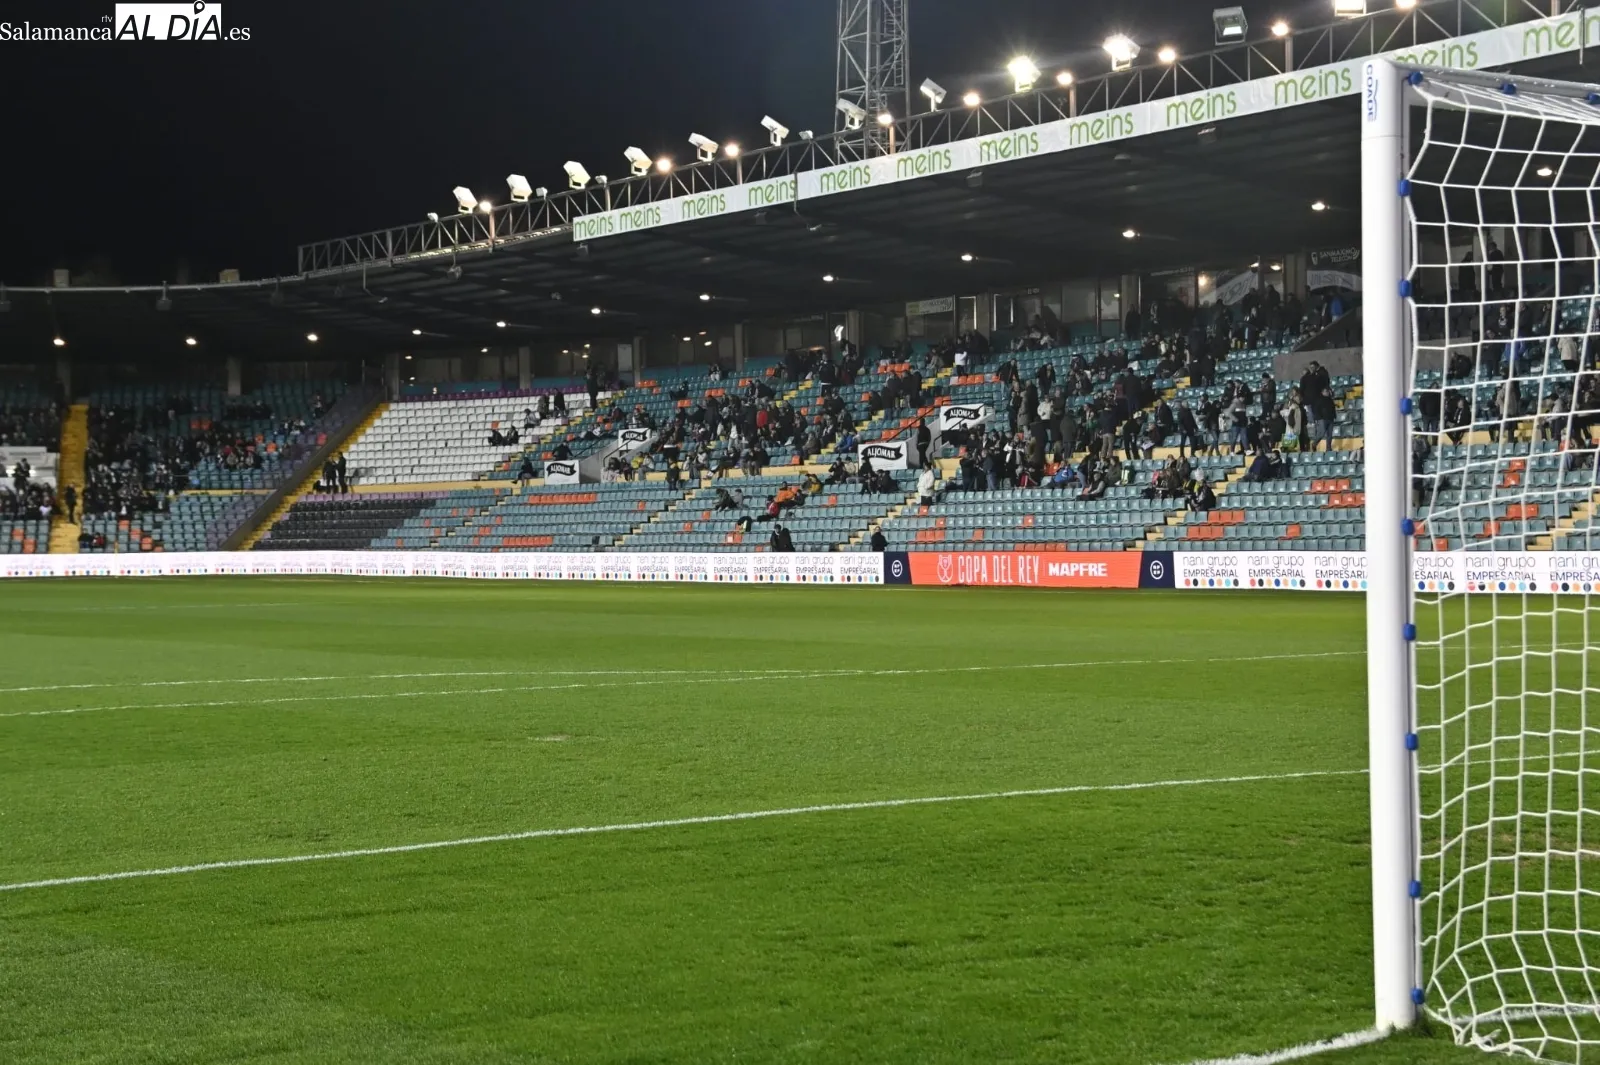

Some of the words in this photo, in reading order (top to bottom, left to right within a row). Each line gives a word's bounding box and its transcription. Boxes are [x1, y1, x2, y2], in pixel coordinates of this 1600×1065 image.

[1274, 66, 1351, 106] meins
[1166, 88, 1236, 127] meins
[1069, 109, 1134, 145] meins
[979, 130, 1039, 163] meins
[897, 148, 952, 179] meins
[820, 164, 871, 193] meins
[748, 178, 796, 206] meins
[681, 193, 726, 219] meins
[619, 206, 661, 231] meins
[574, 215, 613, 240] meins
[867, 447, 896, 459] ALJOMAR
[840, 555, 857, 565] nani
[859, 556, 880, 568] grupo
[1183, 555, 1204, 566] nani
[1207, 556, 1238, 570] grupo
[1247, 555, 1270, 566] nani
[1272, 556, 1305, 570] grupo
[1314, 554, 1338, 566] nani
[1416, 556, 1454, 570] grupo
[1465, 554, 1493, 567] nani
[1497, 556, 1536, 570] grupo
[1549, 553, 1578, 568] nani
[795, 567, 834, 575] EMPRESARIAL
[840, 567, 880, 575] EMPRESARIAL
[957, 555, 987, 583] COPA
[993, 555, 1014, 583] DEL
[1018, 555, 1040, 584] REY
[1048, 562, 1108, 577] MAPFRE
[1183, 568, 1239, 578] EMPRESARIAL
[1248, 569, 1305, 578] EMPRESARIAL
[1466, 570, 1537, 581] EMPRESARIAL
